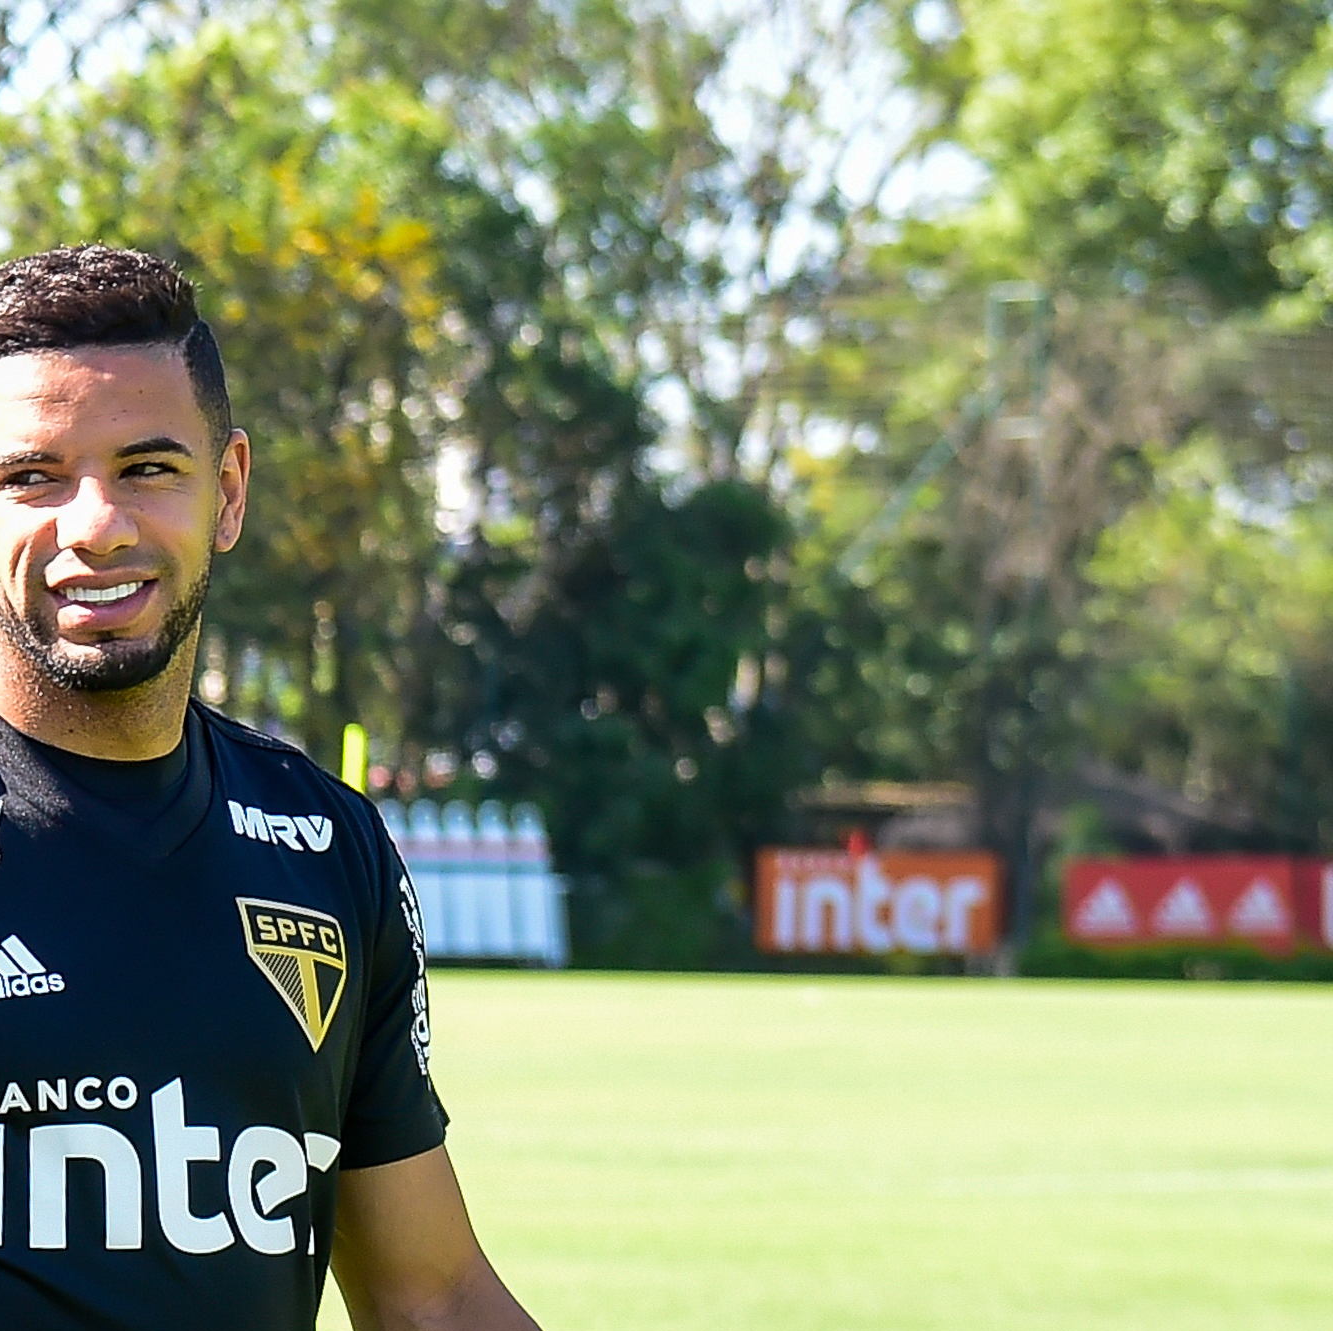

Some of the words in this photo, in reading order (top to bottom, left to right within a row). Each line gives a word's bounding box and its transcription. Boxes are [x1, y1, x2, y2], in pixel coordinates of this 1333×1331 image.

[227, 800, 333, 852] MRV
[774, 853, 984, 953] inter
[256, 914, 338, 954] SPFC
